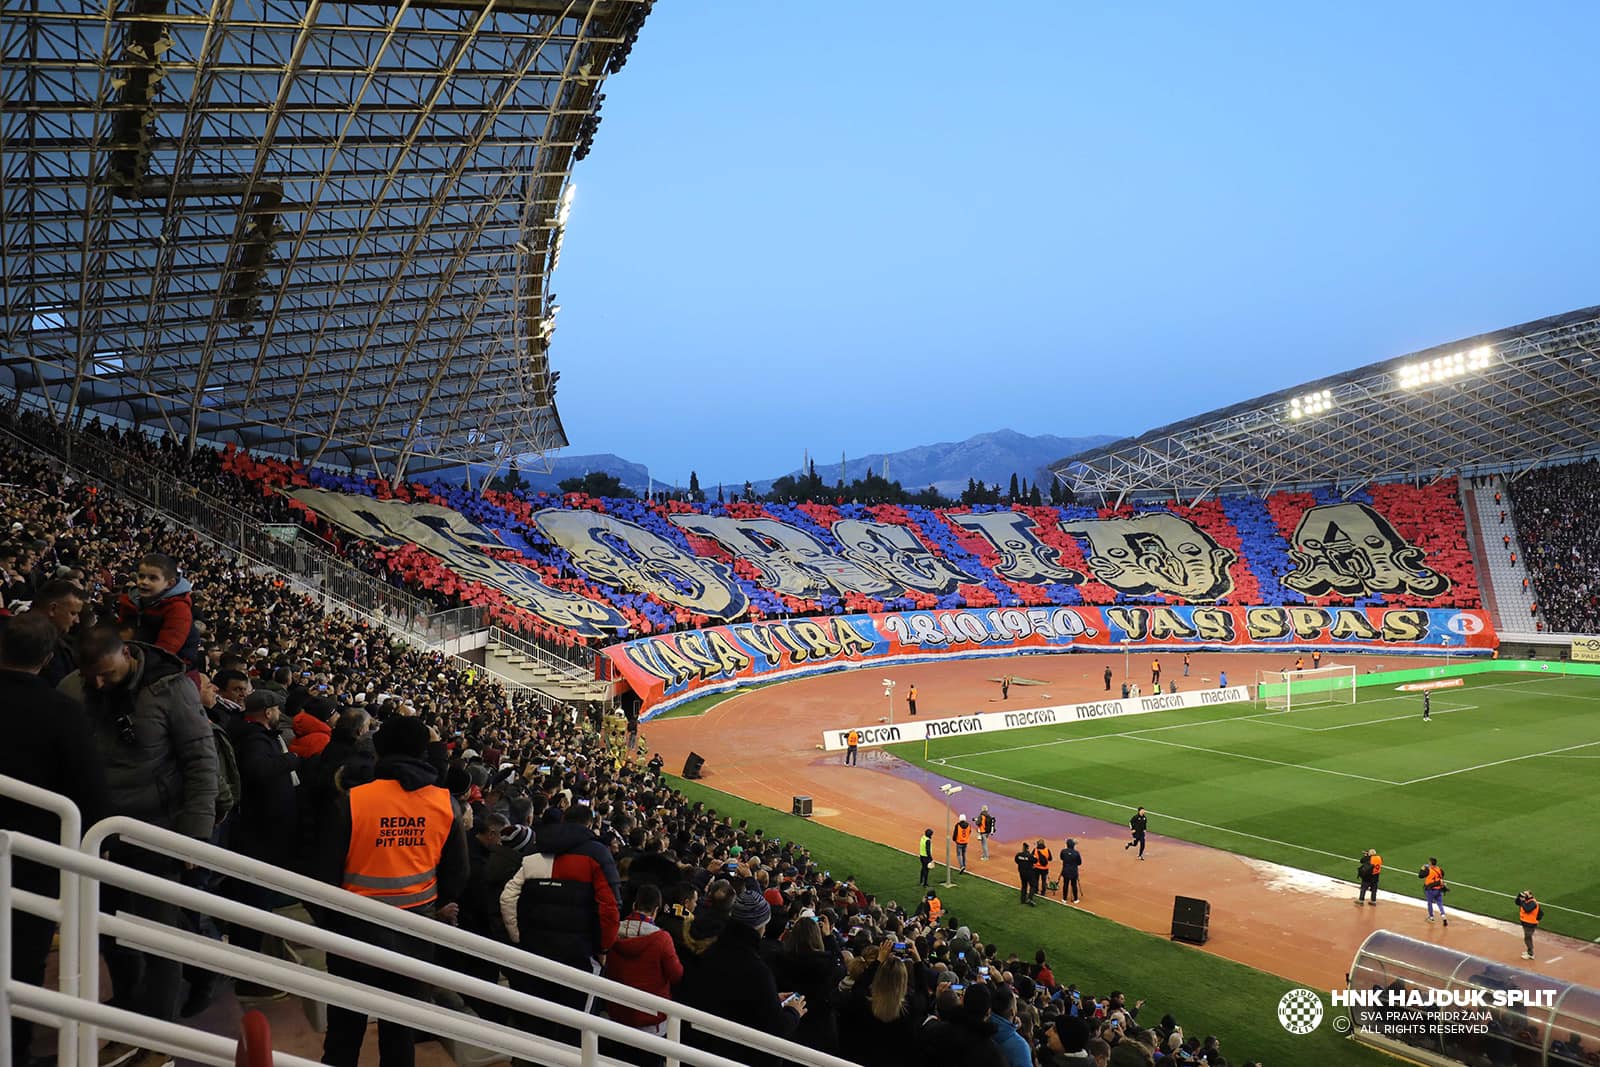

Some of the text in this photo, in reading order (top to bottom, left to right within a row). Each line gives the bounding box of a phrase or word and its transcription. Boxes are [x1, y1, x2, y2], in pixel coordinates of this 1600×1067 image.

[735, 617, 874, 665] VIRA
[1107, 606, 1235, 642] VAŠ
[1247, 606, 1429, 642] SPAS
[926, 717, 982, 736] macron
[1004, 708, 1056, 727] macron
[1076, 702, 1123, 719] macron
[1141, 694, 1185, 711] macron
[1200, 688, 1241, 704] macron
[380, 816, 426, 828] REDAR
[376, 838, 426, 847] PIT BULL
